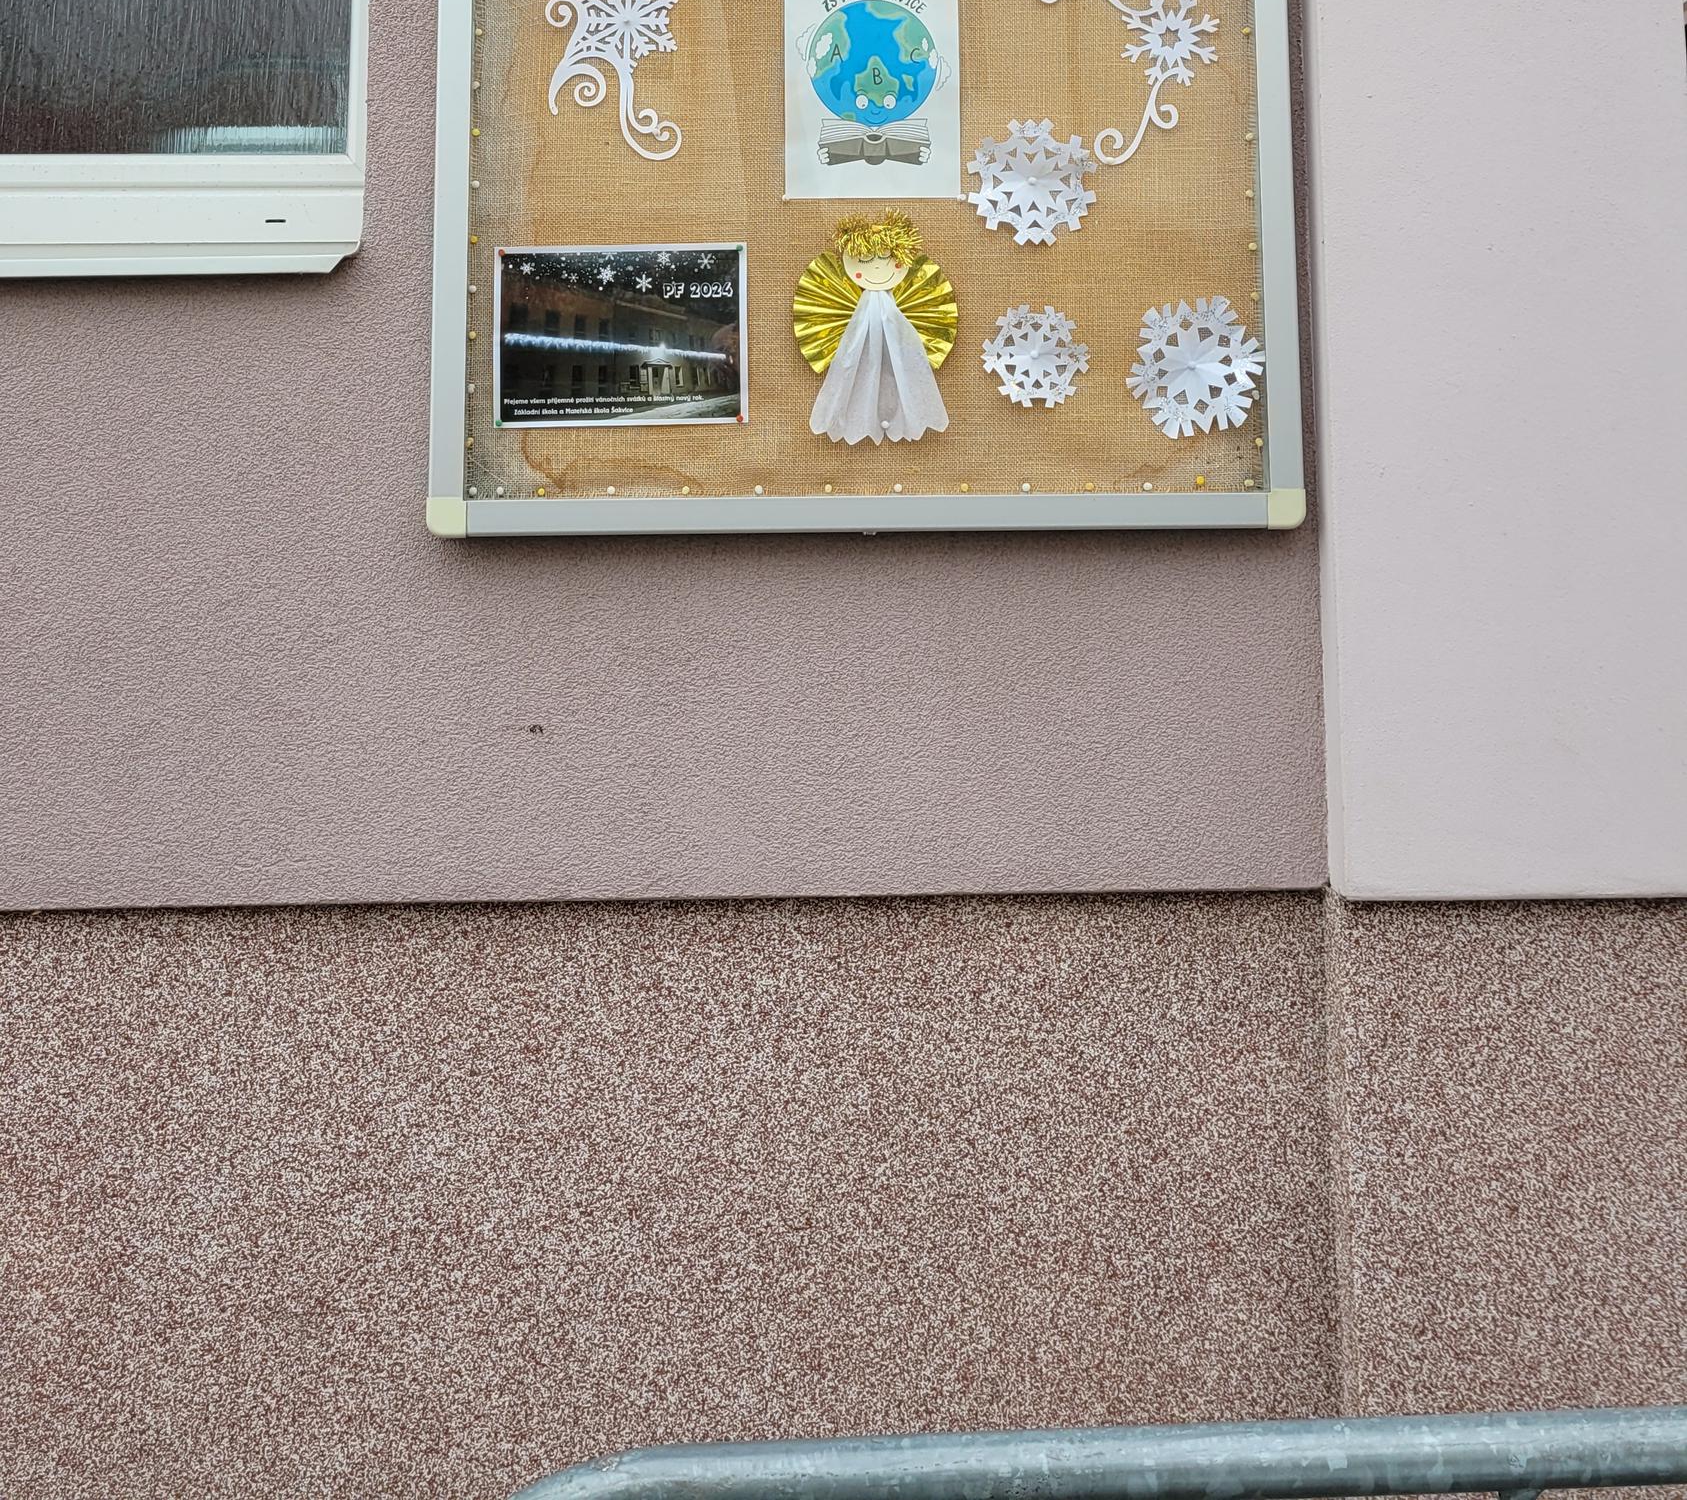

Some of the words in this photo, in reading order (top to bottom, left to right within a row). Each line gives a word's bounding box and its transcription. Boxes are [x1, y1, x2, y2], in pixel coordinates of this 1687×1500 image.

[830, 43, 844, 64] A
[910, 47, 921, 64] C
[872, 67, 883, 86] B
[662, 282, 685, 299] PF
[690, 281, 734, 298] 2024
